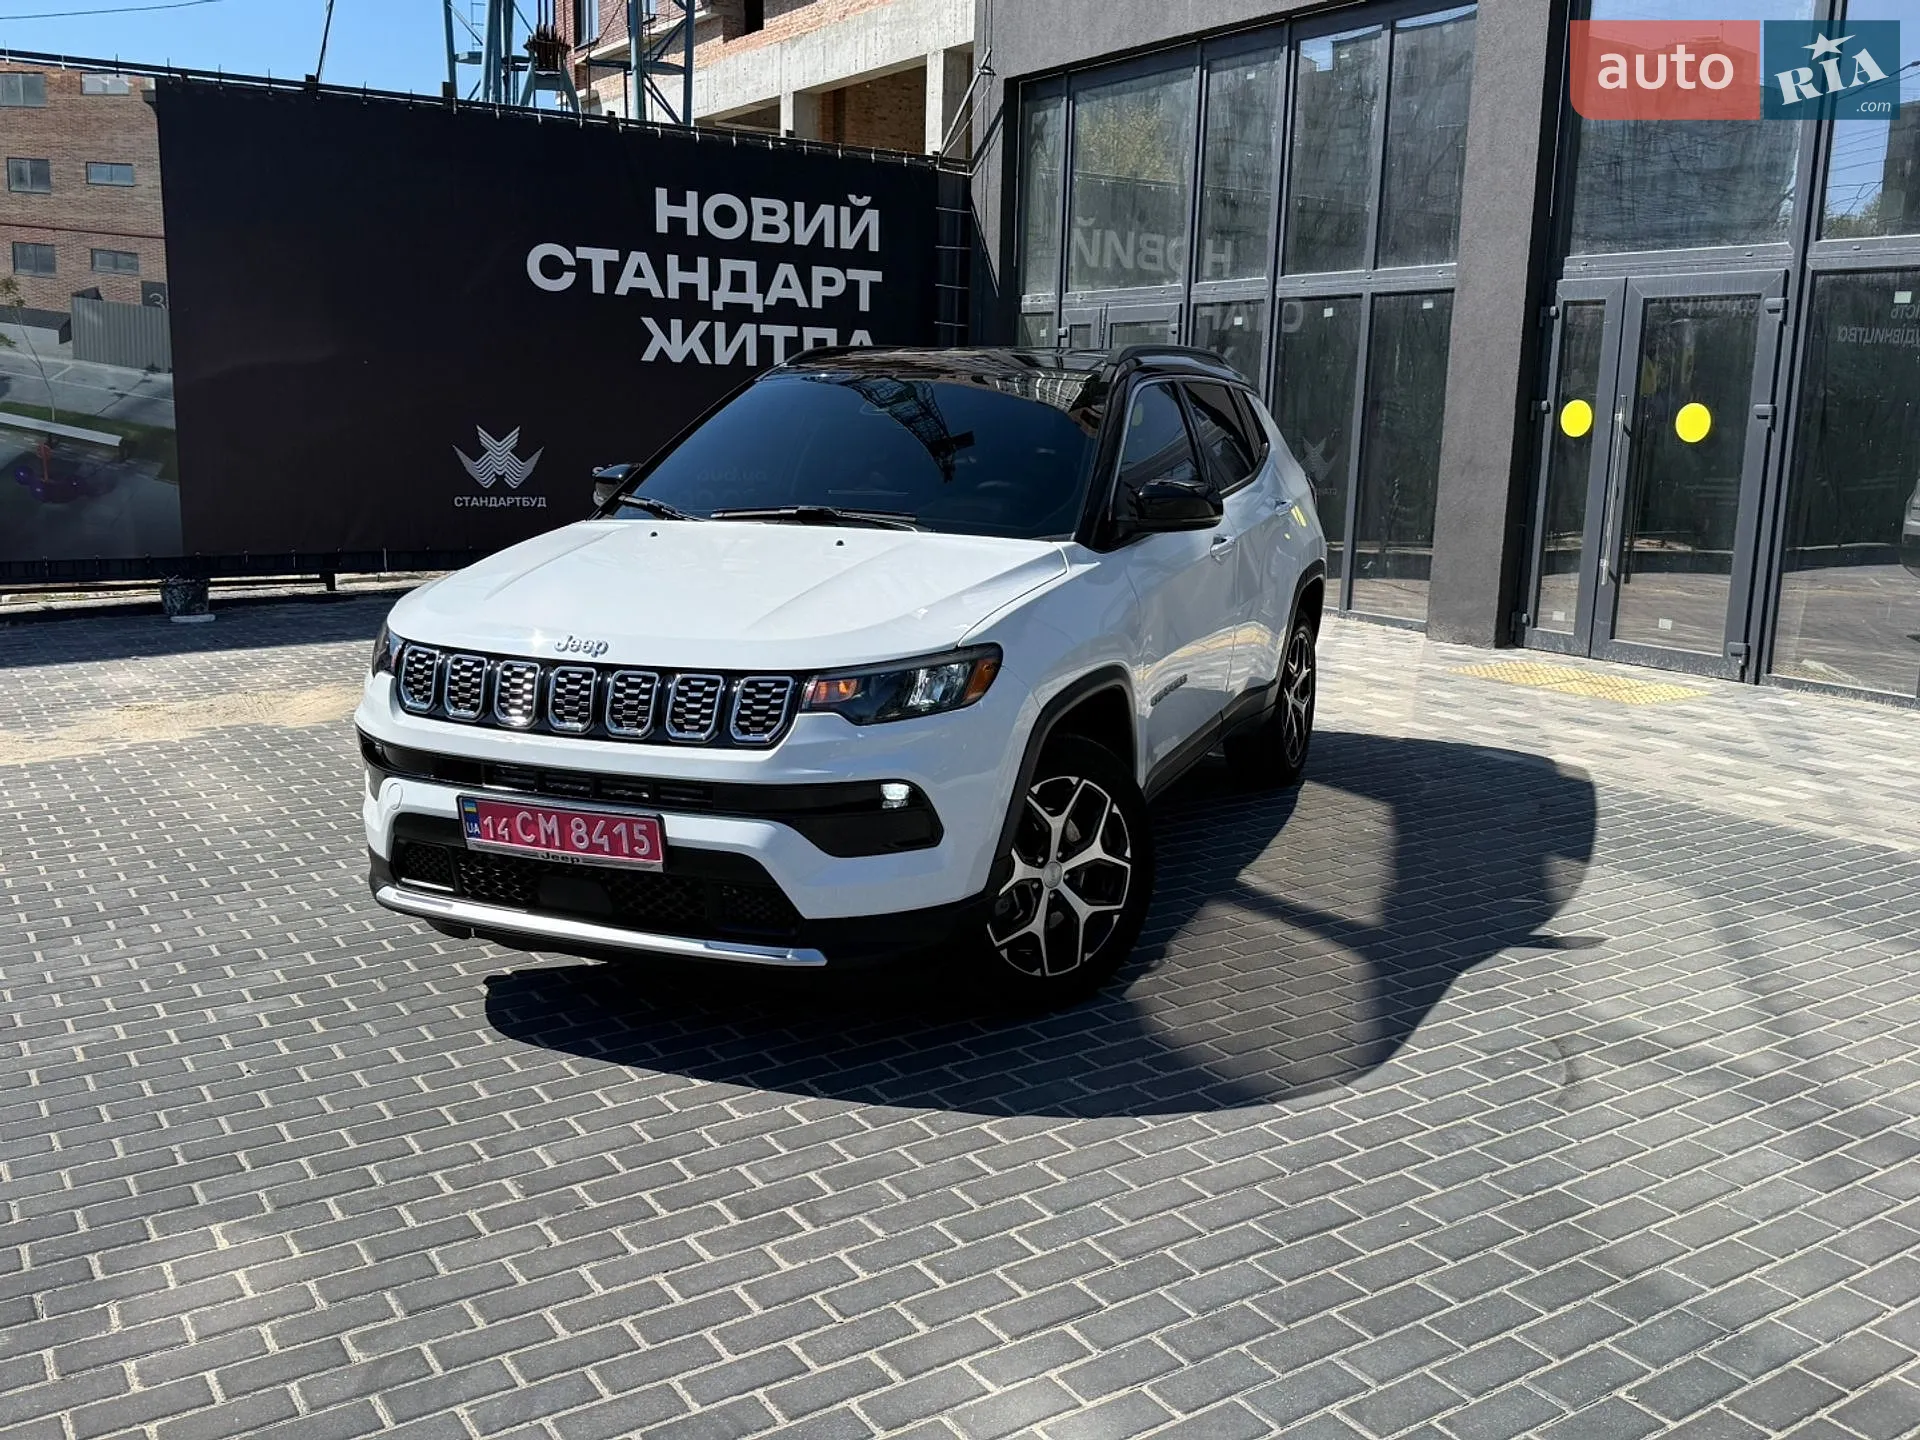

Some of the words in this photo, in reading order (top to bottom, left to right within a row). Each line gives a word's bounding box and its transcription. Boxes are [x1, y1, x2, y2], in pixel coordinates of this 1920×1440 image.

[654, 187, 880, 252] НОВИЙ
[526, 242, 883, 313] СТАНДАРТ
[453, 495, 547, 508] СТАНДАРТБУД
[554, 634, 609, 658] Jeep
[466, 822, 481, 835] UA
[483, 815, 511, 841] 14
[569, 817, 651, 856] 8415
[540, 850, 581, 864] Jeep
